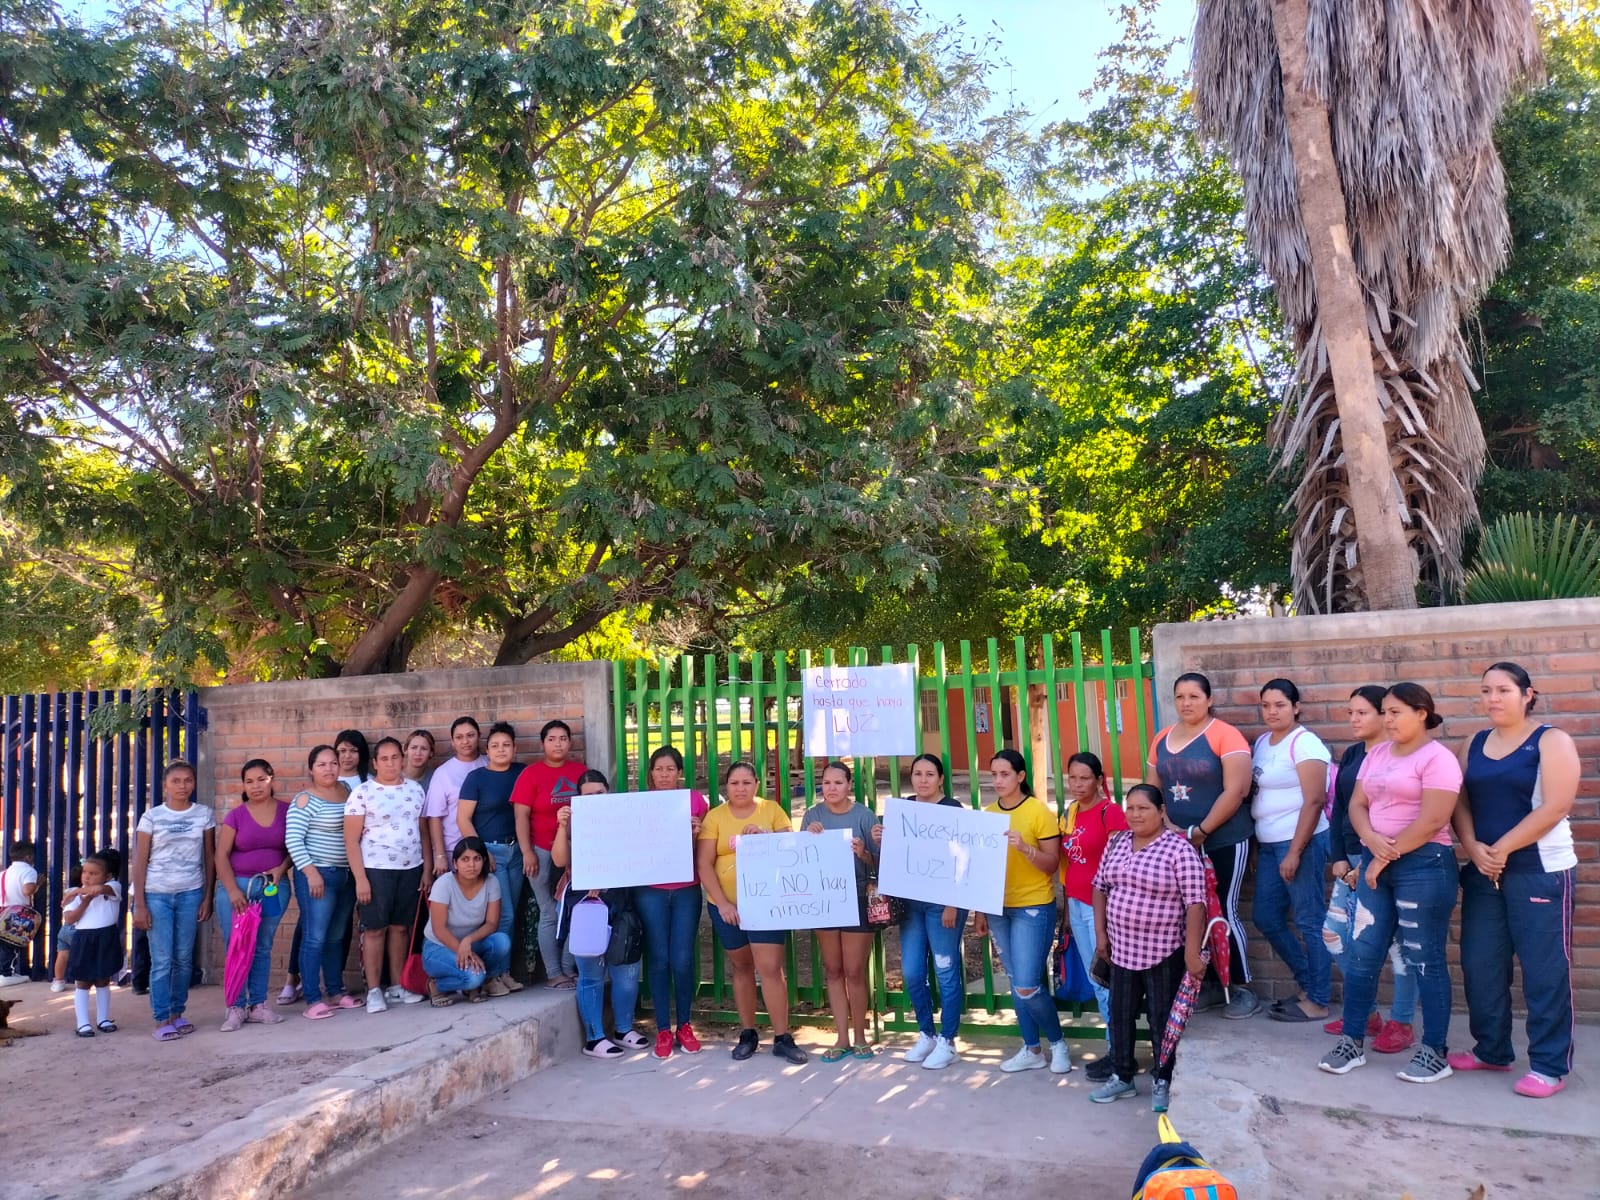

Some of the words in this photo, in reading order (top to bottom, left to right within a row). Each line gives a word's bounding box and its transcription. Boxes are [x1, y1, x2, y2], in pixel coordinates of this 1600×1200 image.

[815, 672, 867, 689] Cerrado
[812, 694, 843, 707] hasta
[848, 697, 871, 710] que
[834, 713, 880, 734] LUZ
[901, 812, 999, 849] Necesitamos
[776, 839, 820, 867] Sin
[742, 873, 771, 898] luz
[781, 872, 809, 894] NO
[819, 869, 848, 904] hay
